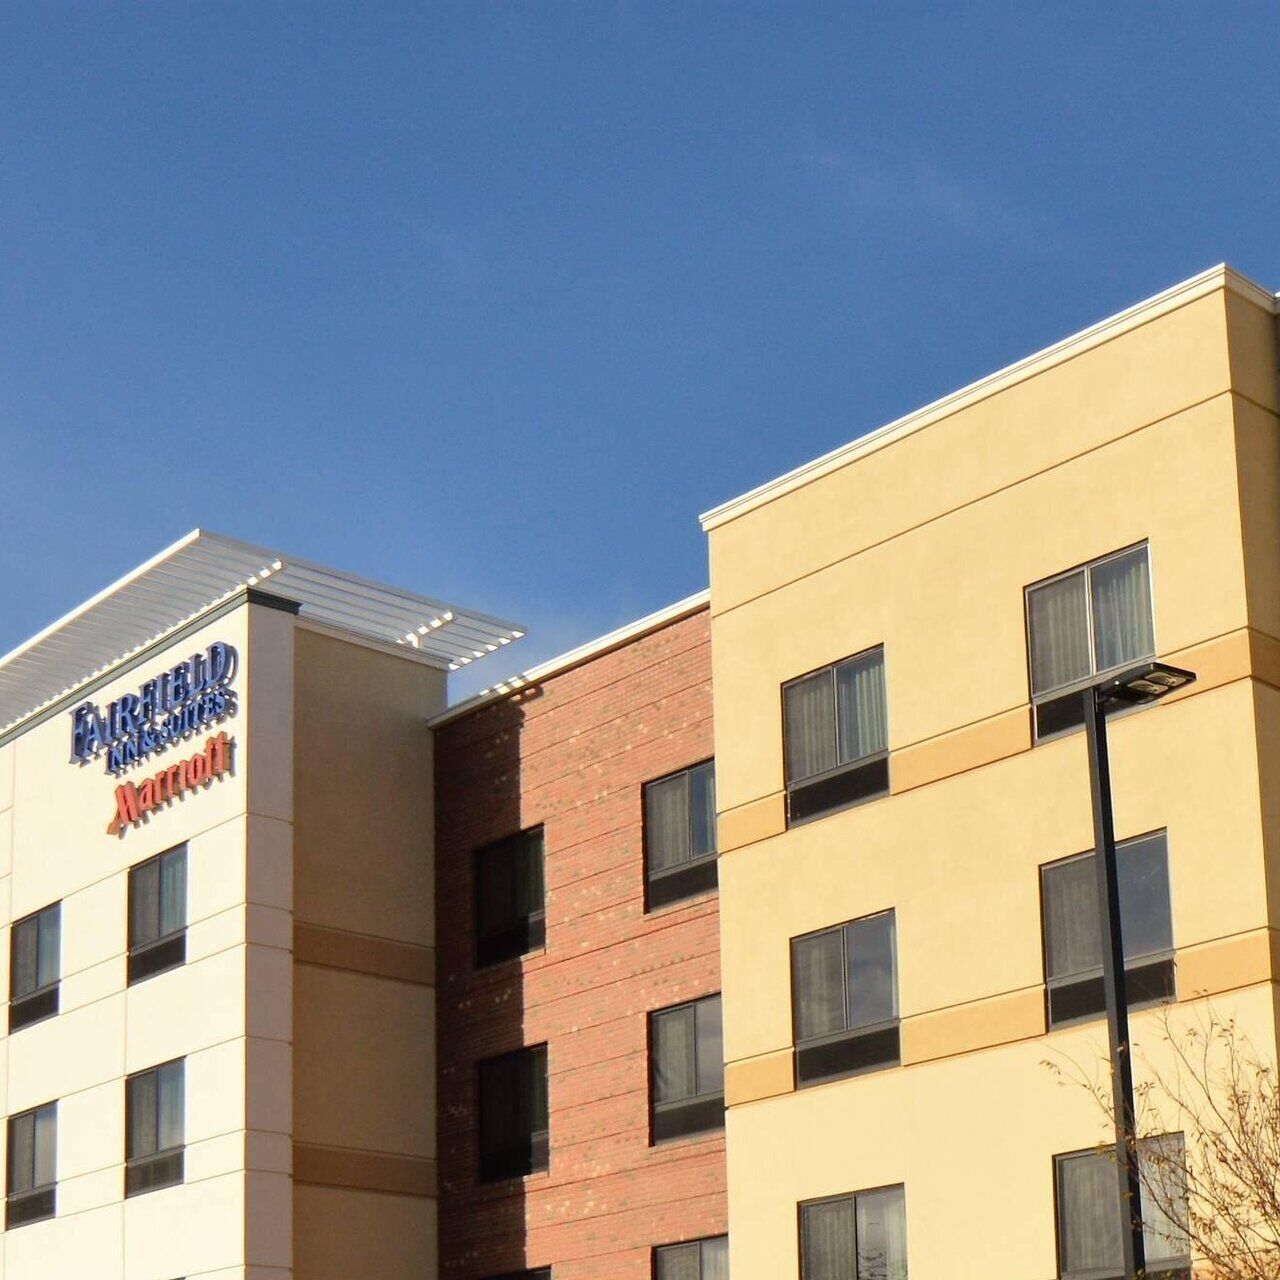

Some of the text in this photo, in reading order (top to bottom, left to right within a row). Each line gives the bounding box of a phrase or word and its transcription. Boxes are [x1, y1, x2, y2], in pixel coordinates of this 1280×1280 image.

[69, 641, 235, 766] FAIRFIELD
[105, 736, 141, 777] INN
[161, 688, 233, 746] SUITES
[106, 731, 232, 836] Marriott
